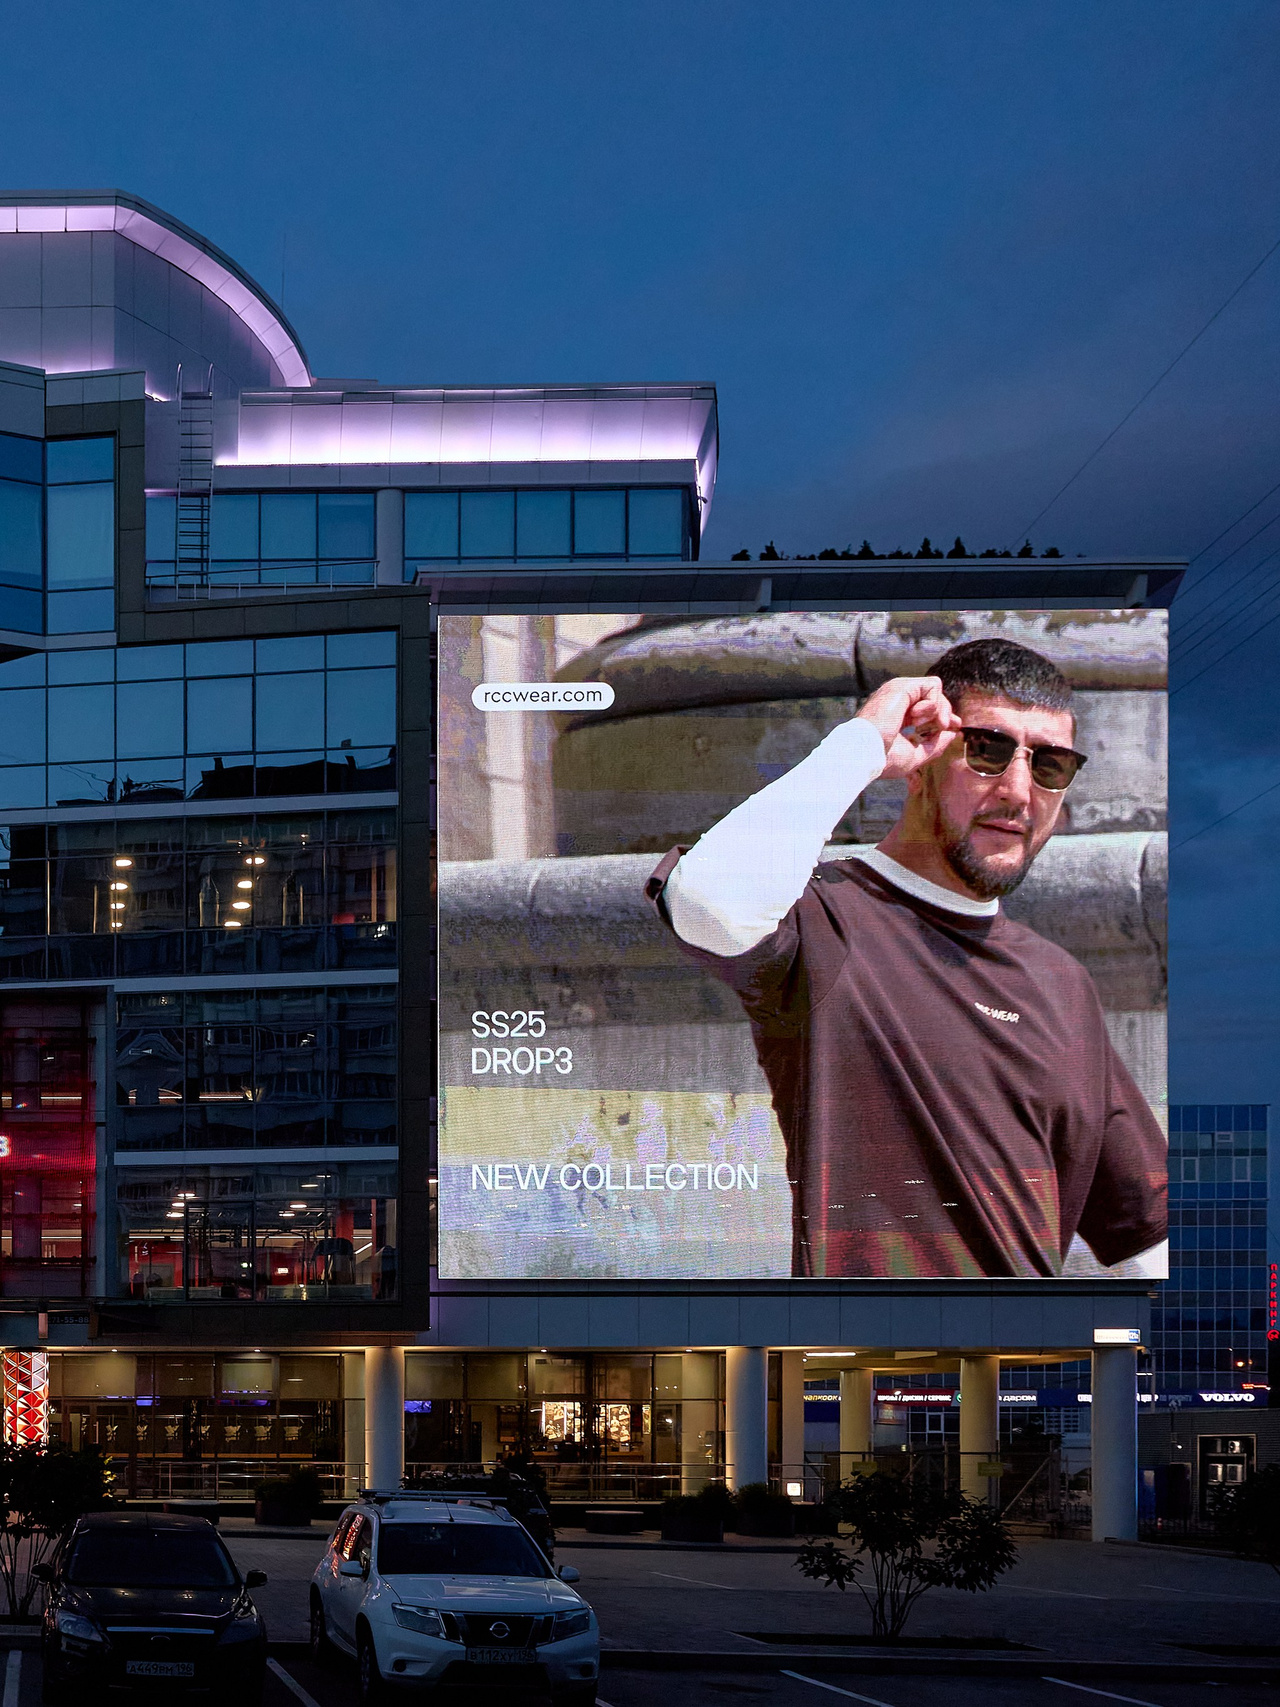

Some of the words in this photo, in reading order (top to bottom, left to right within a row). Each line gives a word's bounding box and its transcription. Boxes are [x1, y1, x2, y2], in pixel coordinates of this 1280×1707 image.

[484, 690, 602, 703] rccwear.com
[471, 1011, 546, 1039] SS25
[471, 1047, 573, 1075] DROP3
[471, 1163, 551, 1191] NEW
[559, 1163, 759, 1191] COLLECTION
[1269, 1263, 1278, 1327] ПАРКИНГ
[48, 1316, 89, 1324] 71-55-88
[1199, 1393, 1255, 1402] VOLVO
